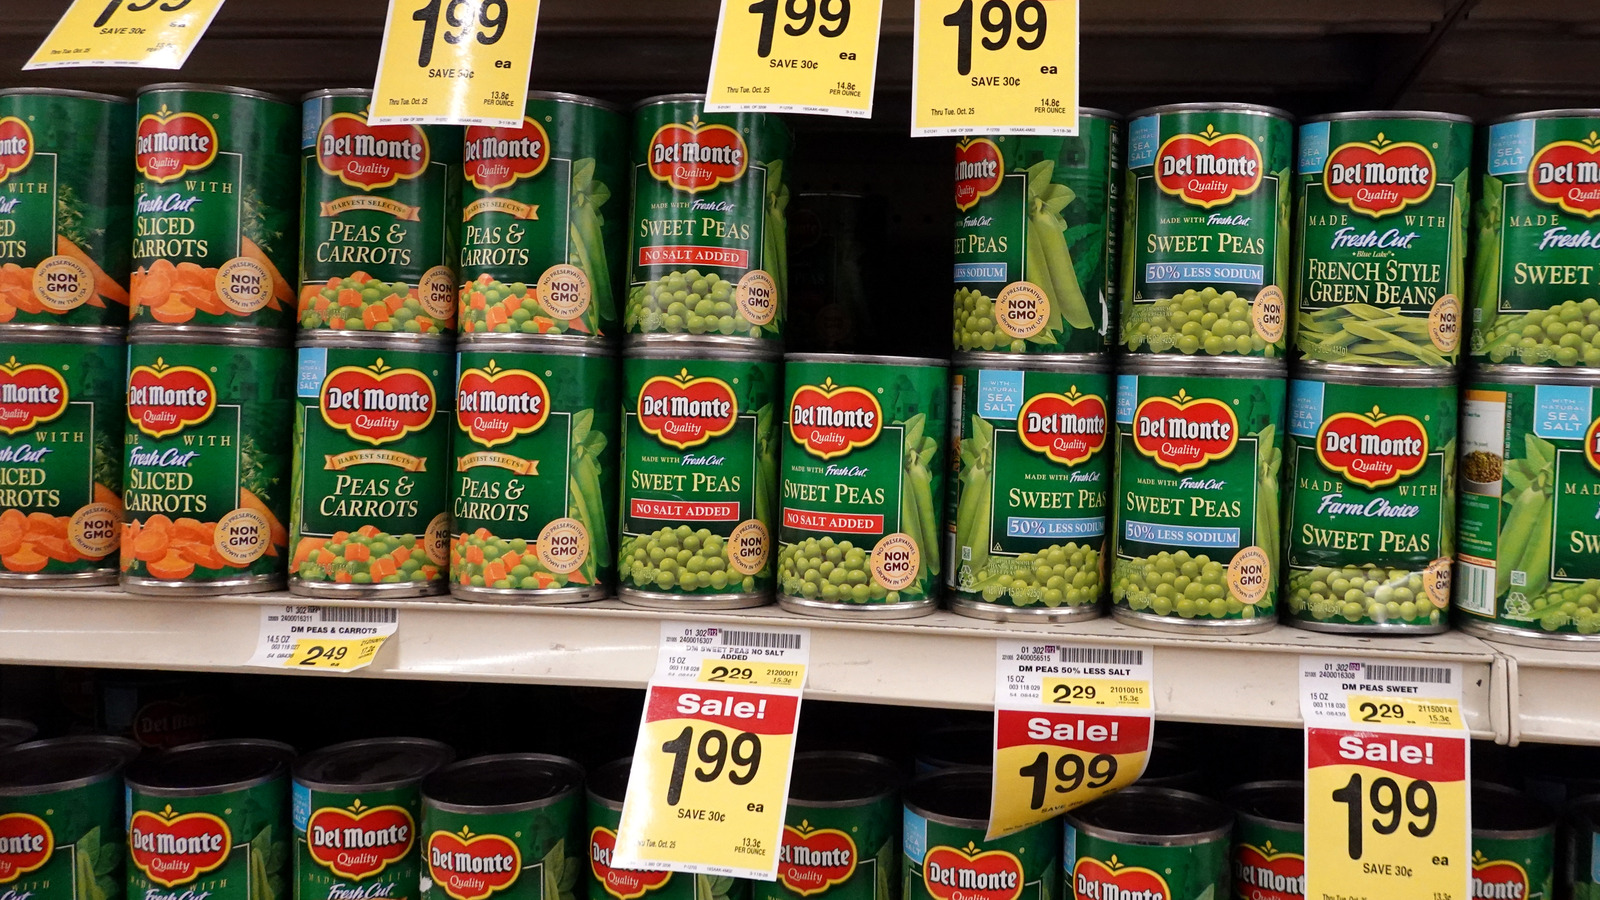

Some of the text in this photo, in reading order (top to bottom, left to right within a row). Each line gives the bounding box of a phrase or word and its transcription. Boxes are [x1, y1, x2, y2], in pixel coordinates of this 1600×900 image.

[494, 58, 512, 69] ea
[770, 59, 818, 69] SAVE 30¢
[1040, 66, 1058, 74] ea
[837, 82, 855, 90] 14.8¢
[972, 77, 1020, 86] SAVE 30¢
[1041, 98, 1060, 106] 14.8¢
[154, 132, 209, 152] Monte
[324, 134, 422, 160] Del Monte
[676, 166, 712, 180] Quality
[1163, 154, 1256, 176] Del Monte
[1332, 163, 1430, 184] Del Monte
[186, 182, 232, 194] WITH
[1188, 179, 1228, 194] Quality
[137, 216, 195, 236] SLICED
[640, 218, 750, 240] SWEET PEAS
[1183, 216, 1206, 224] WITH
[1309, 215, 1446, 228] MADE WITH
[1510, 214, 1558, 227] MADE
[329, 221, 407, 244] PEAS &
[132, 239, 208, 258] CARROTS
[969, 234, 1008, 253] PEAS
[1147, 232, 1264, 254] SWEET PEAS
[316, 242, 411, 266] CARROTS
[645, 250, 740, 262] NO SALT ADDED
[966, 266, 1004, 277] SODIUM
[1148, 265, 1261, 280] 50% LESS SODIUM
[1308, 258, 1440, 282] FRENCH STYLE
[1514, 262, 1593, 284] SWEET
[748, 288, 770, 298] NON
[1310, 280, 1436, 306] GREEN BEANS
[748, 298, 770, 308] GMO
[1008, 300, 1036, 309] NON
[1008, 309, 1036, 320] GMO
[149, 386, 208, 406] Monte
[987, 394, 1013, 402] SEA
[644, 396, 730, 418] Del Monte
[984, 402, 1016, 412] SALT
[794, 405, 874, 429] Del Monte
[664, 420, 702, 435] Quality
[1140, 417, 1231, 440] Del Monte
[1326, 432, 1421, 456] Del Monte
[1352, 459, 1392, 474] Quality
[130, 468, 193, 490] SLICED
[334, 474, 414, 497] PEAS &
[632, 470, 740, 492] SWEET PEAS
[1300, 478, 1438, 497] MADE WITH
[125, 490, 207, 512] CARROTS
[320, 495, 418, 518] CARROTS
[1009, 488, 1074, 509] SWEET
[1126, 491, 1241, 518] SWEET PEAS
[636, 504, 730, 516] NO SALT ADDED
[230, 526, 258, 536] NON
[1128, 524, 1236, 544] 50% LESS SODIUM
[1302, 524, 1430, 552] SWEET PEAS
[230, 536, 258, 546] GMO
[1360, 684, 1384, 692] PEAS
[677, 693, 767, 719] Sale!
[1028, 718, 1119, 742] Sale!
[1338, 736, 1434, 765] Sale!
[678, 808, 726, 822] SAVE 30¢
[747, 802, 764, 812] ea
[134, 829, 222, 854] Del Monte
[314, 824, 408, 847] Del Monte
[742, 837, 760, 848] 13.3¢
[432, 847, 513, 874] Del Monte
[734, 846, 766, 856] PER OUNCE
[1432, 854, 1449, 866] ea
[152, 857, 190, 872] Quality
[1363, 862, 1412, 877] SAVE 30¢
[930, 863, 1016, 889] Del Monte
